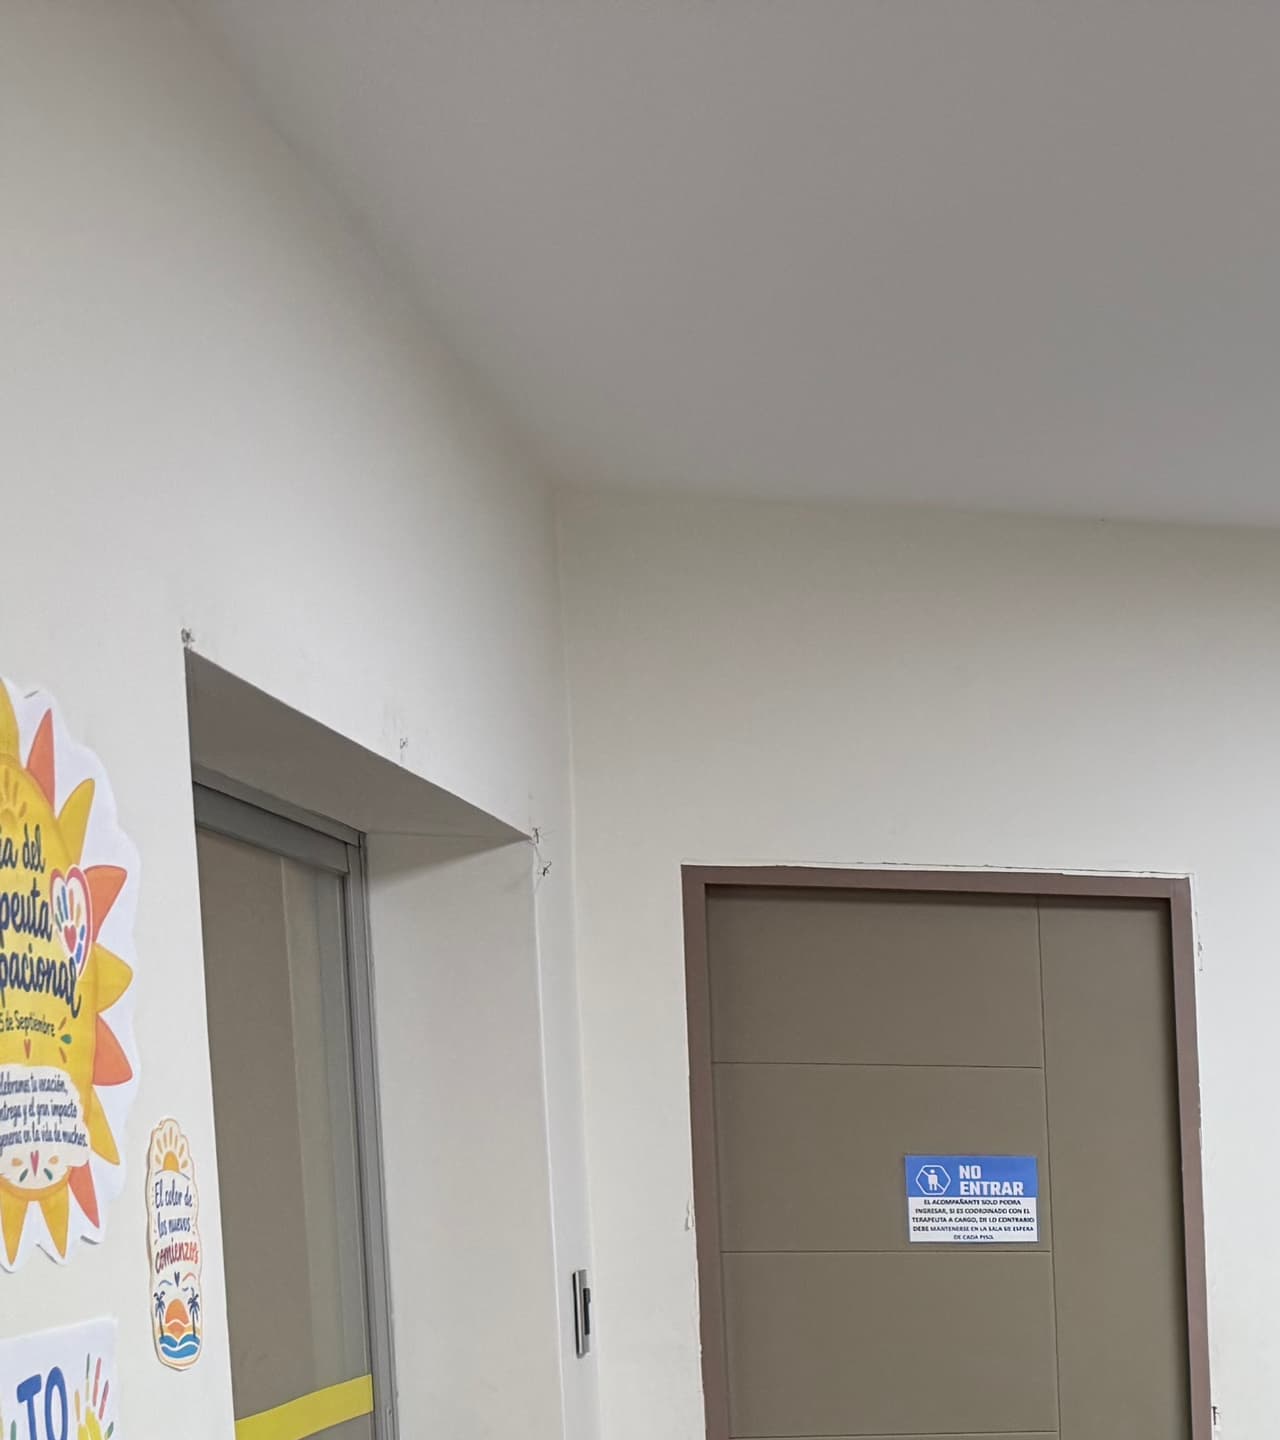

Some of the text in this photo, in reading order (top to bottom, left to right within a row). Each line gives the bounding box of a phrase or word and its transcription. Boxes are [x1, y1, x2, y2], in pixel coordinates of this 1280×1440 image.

[23, 822, 46, 874] del
[6, 1010, 14, 1031] de
[959, 1165, 982, 1179] NO
[155, 1179, 192, 1209] El color de
[960, 1181, 1024, 1196] ENTRAR
[169, 1217, 191, 1233] nuevos
